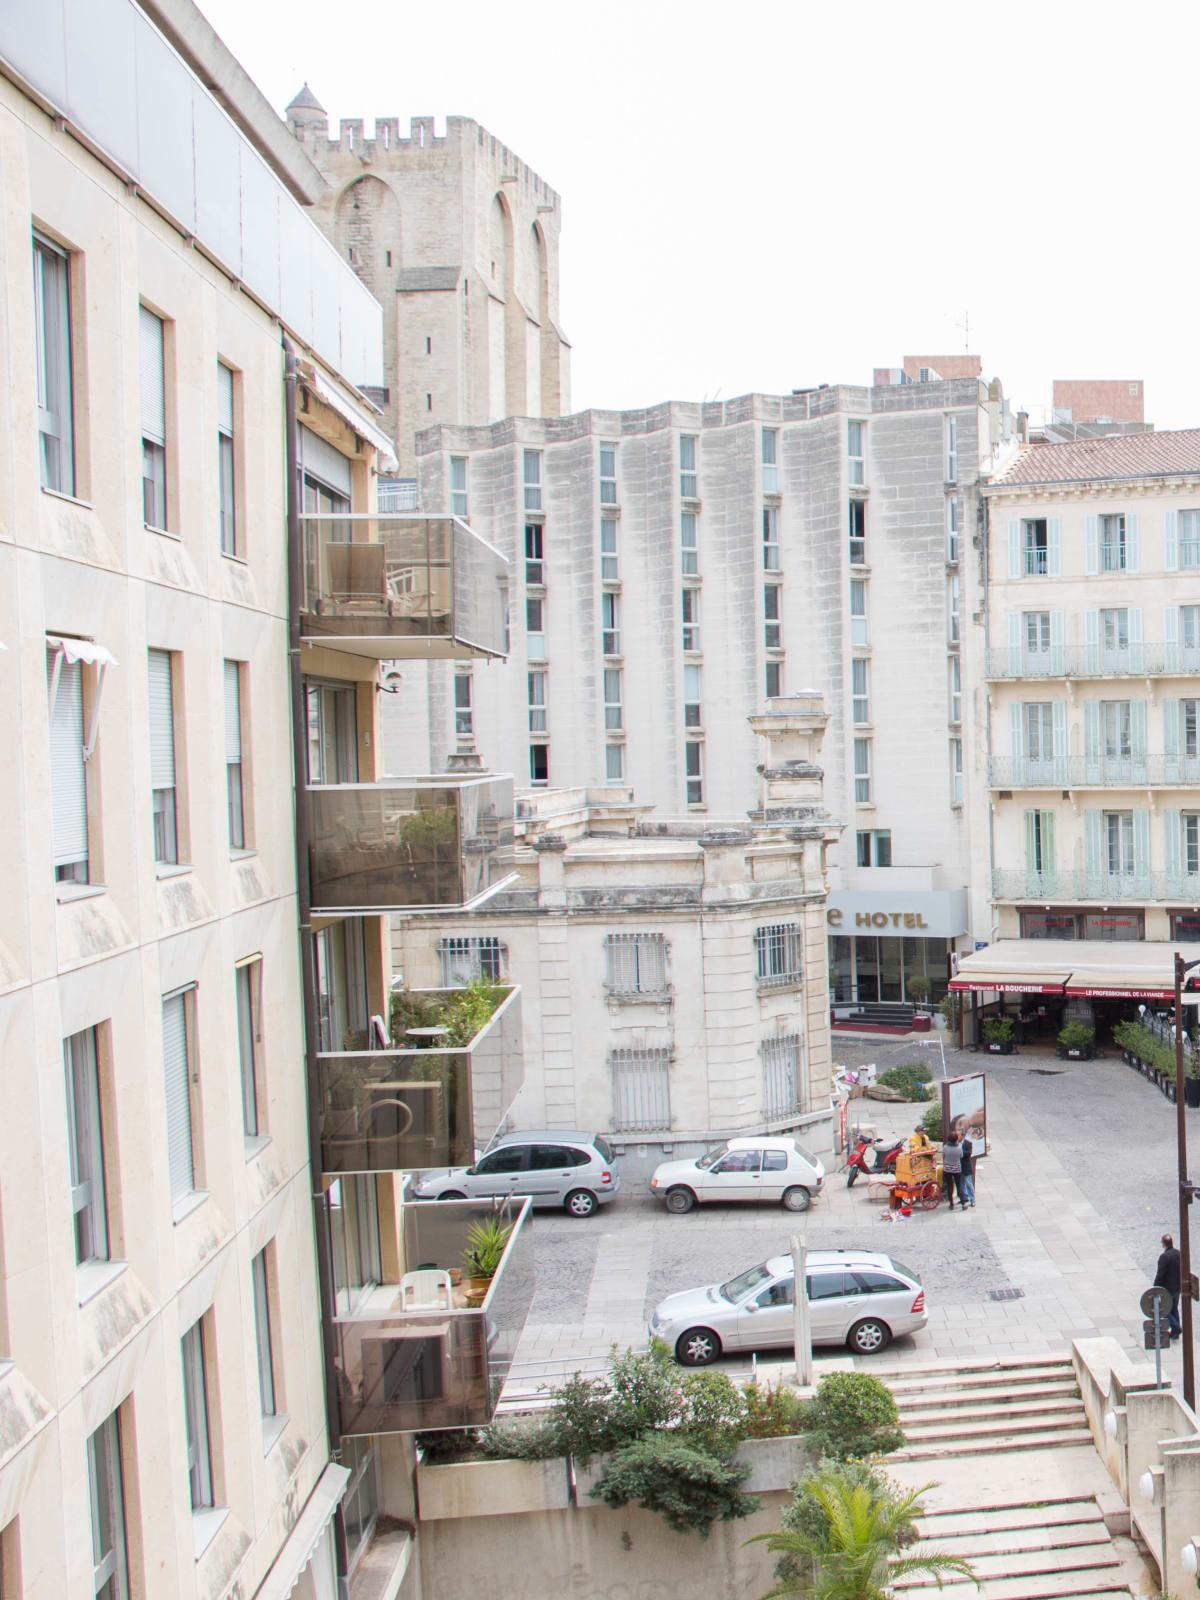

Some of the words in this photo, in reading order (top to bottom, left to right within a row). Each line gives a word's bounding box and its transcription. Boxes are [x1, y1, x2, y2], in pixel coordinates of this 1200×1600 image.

[855, 912, 929, 929] HOTEL
[995, 984, 1004, 992] LA
[1005, 985, 1043, 993] BOUCHERIE
